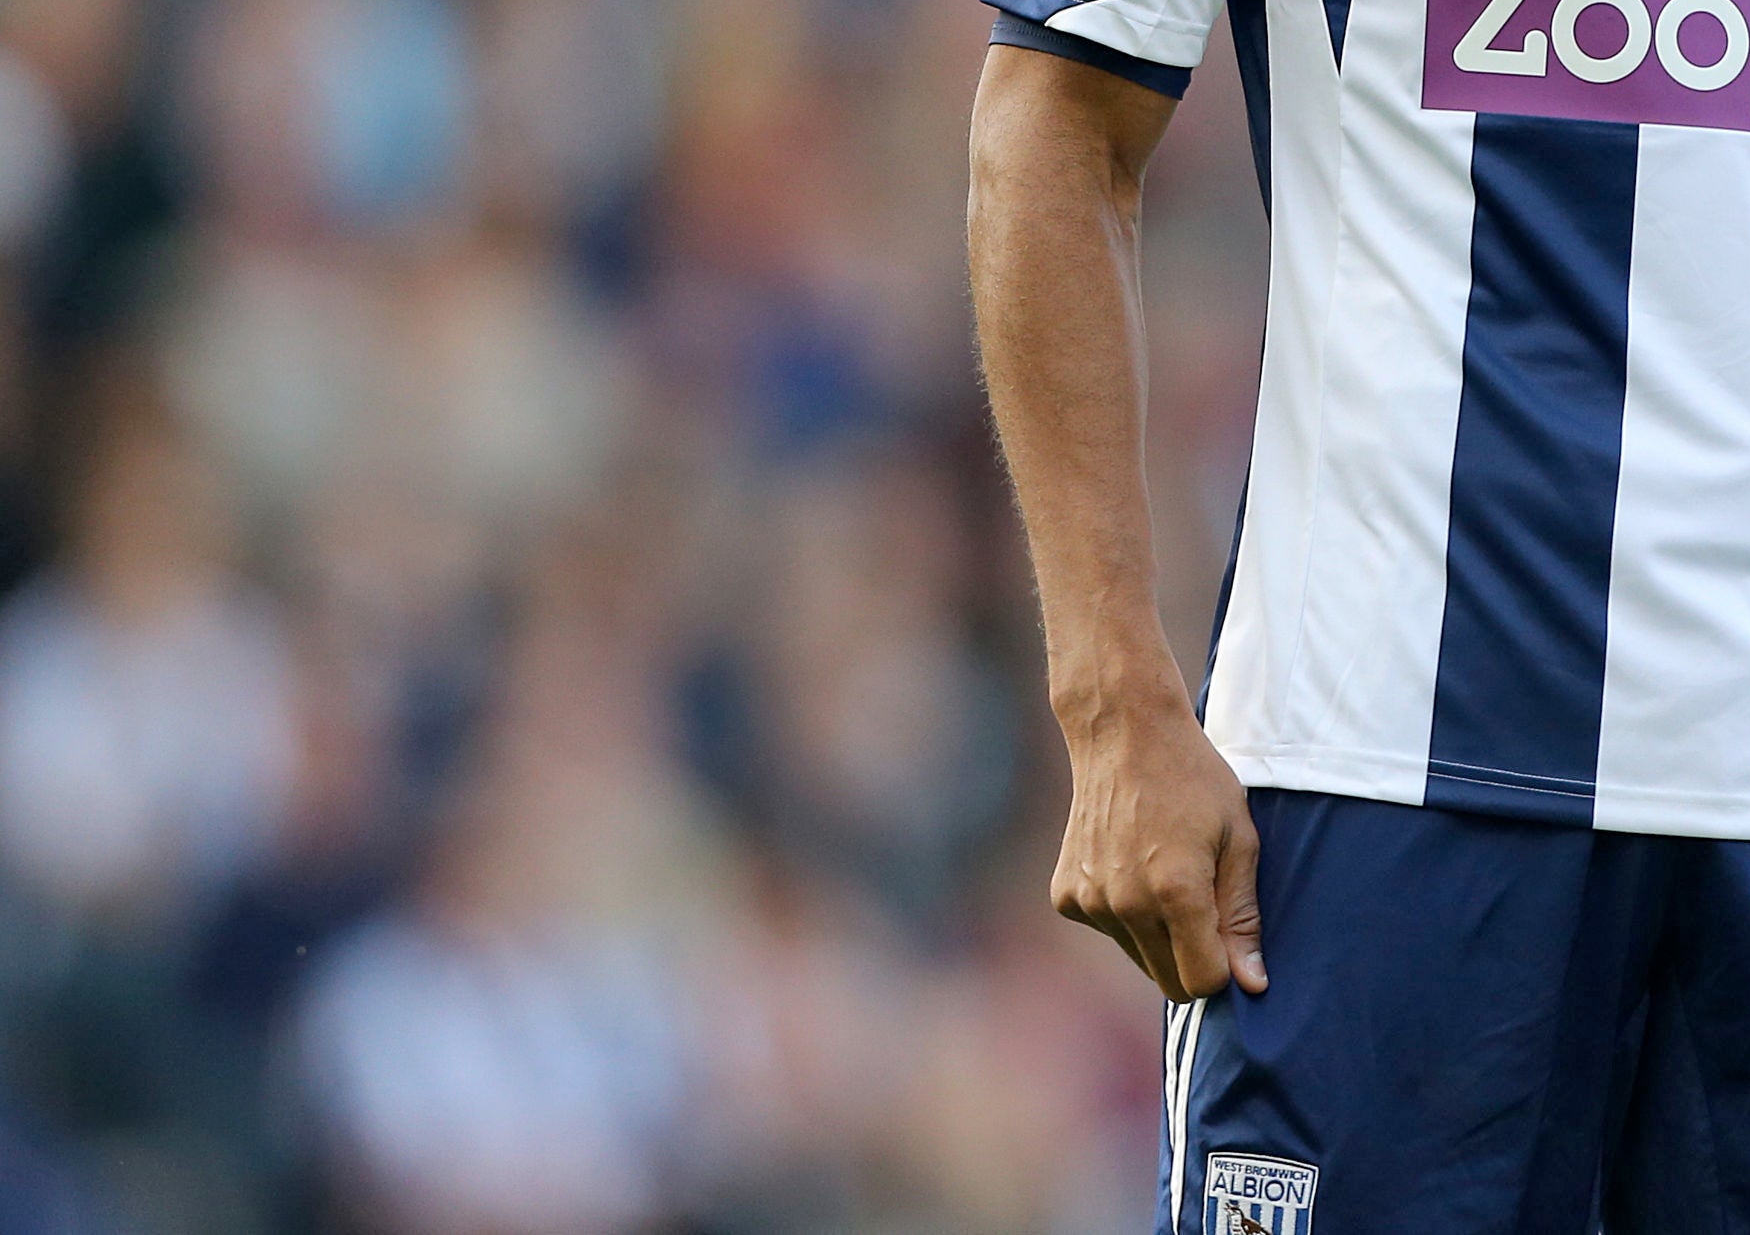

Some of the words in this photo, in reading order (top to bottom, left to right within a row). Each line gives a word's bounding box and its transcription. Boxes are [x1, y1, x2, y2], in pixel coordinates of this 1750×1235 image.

[1214, 1159, 1242, 1172] WEST
[1245, 1166, 1309, 1181] BROMWICH
[1212, 1172, 1306, 1204] ALBION
